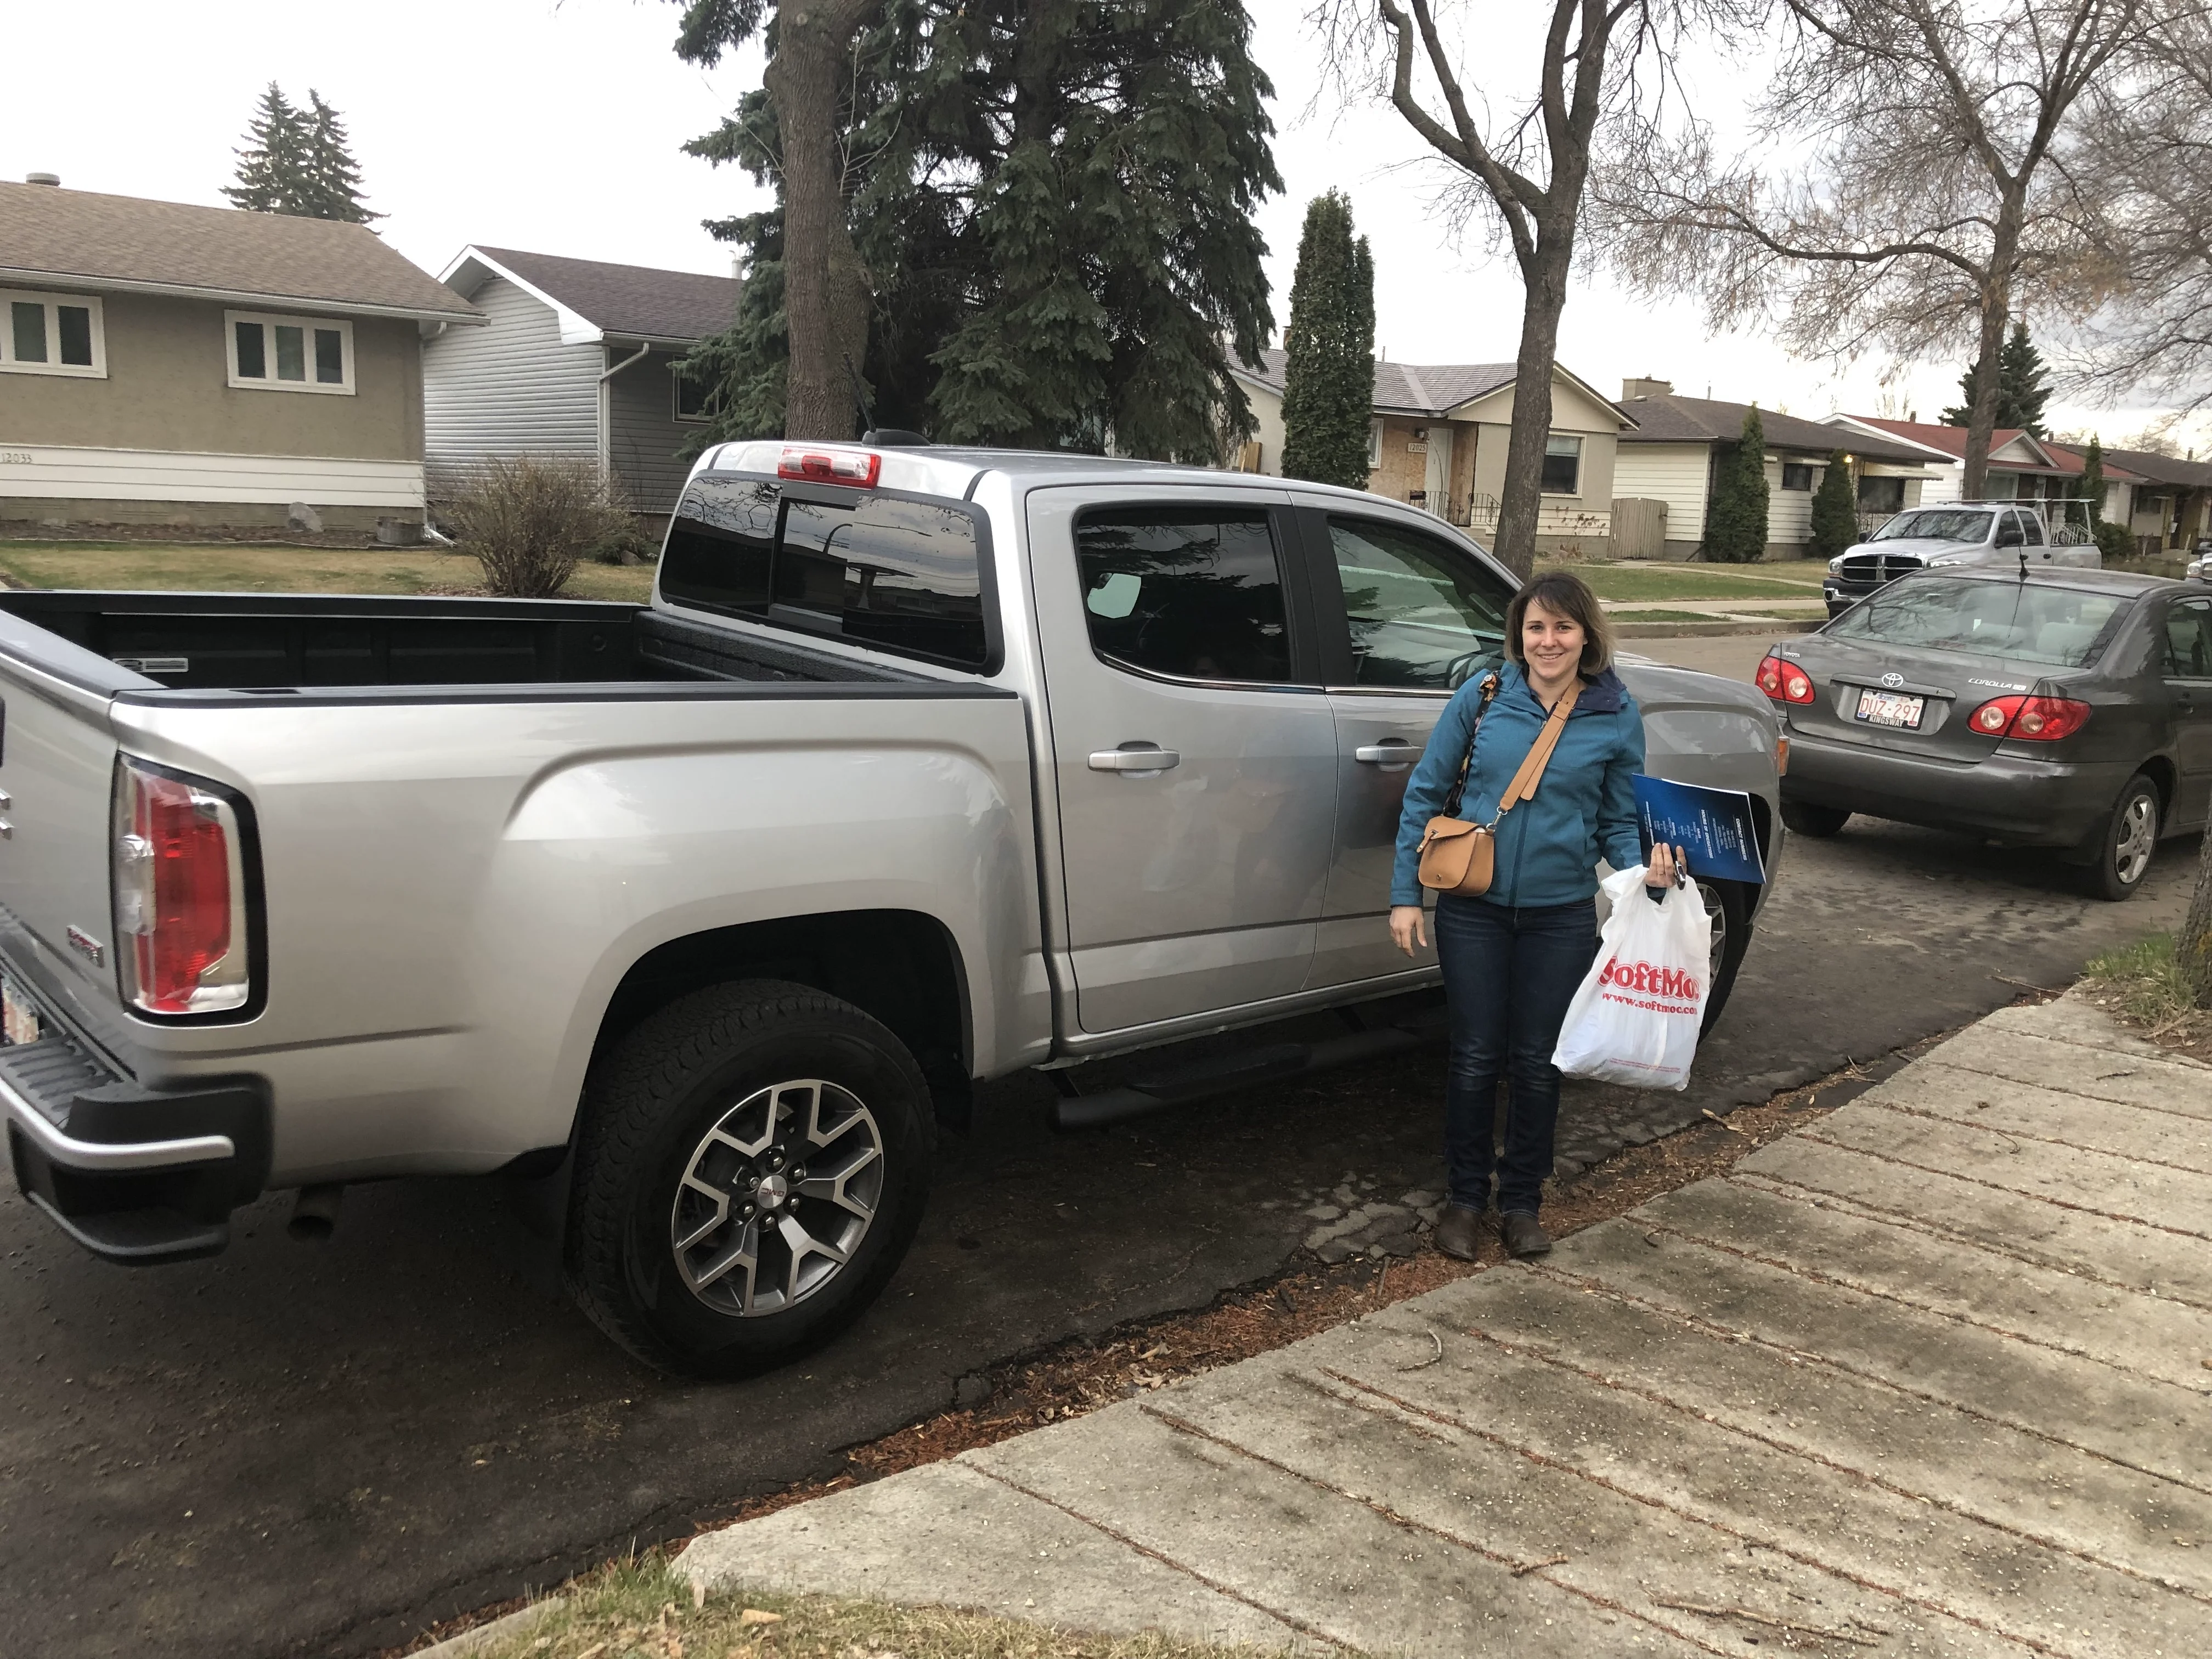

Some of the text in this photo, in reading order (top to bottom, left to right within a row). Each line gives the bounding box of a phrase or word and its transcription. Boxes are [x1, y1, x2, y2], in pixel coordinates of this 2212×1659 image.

[2, 453, 32, 463] 12033
[1968, 678, 2012, 689] COROLLA
[1869, 714, 1905, 727] KINGSWAY
[1705, 832, 1714, 859] OPERATIONS
[1740, 839, 1748, 861] NUMBERS
[1599, 956, 1700, 1001] SoftMo
[761, 1187, 785, 1197] GMC
